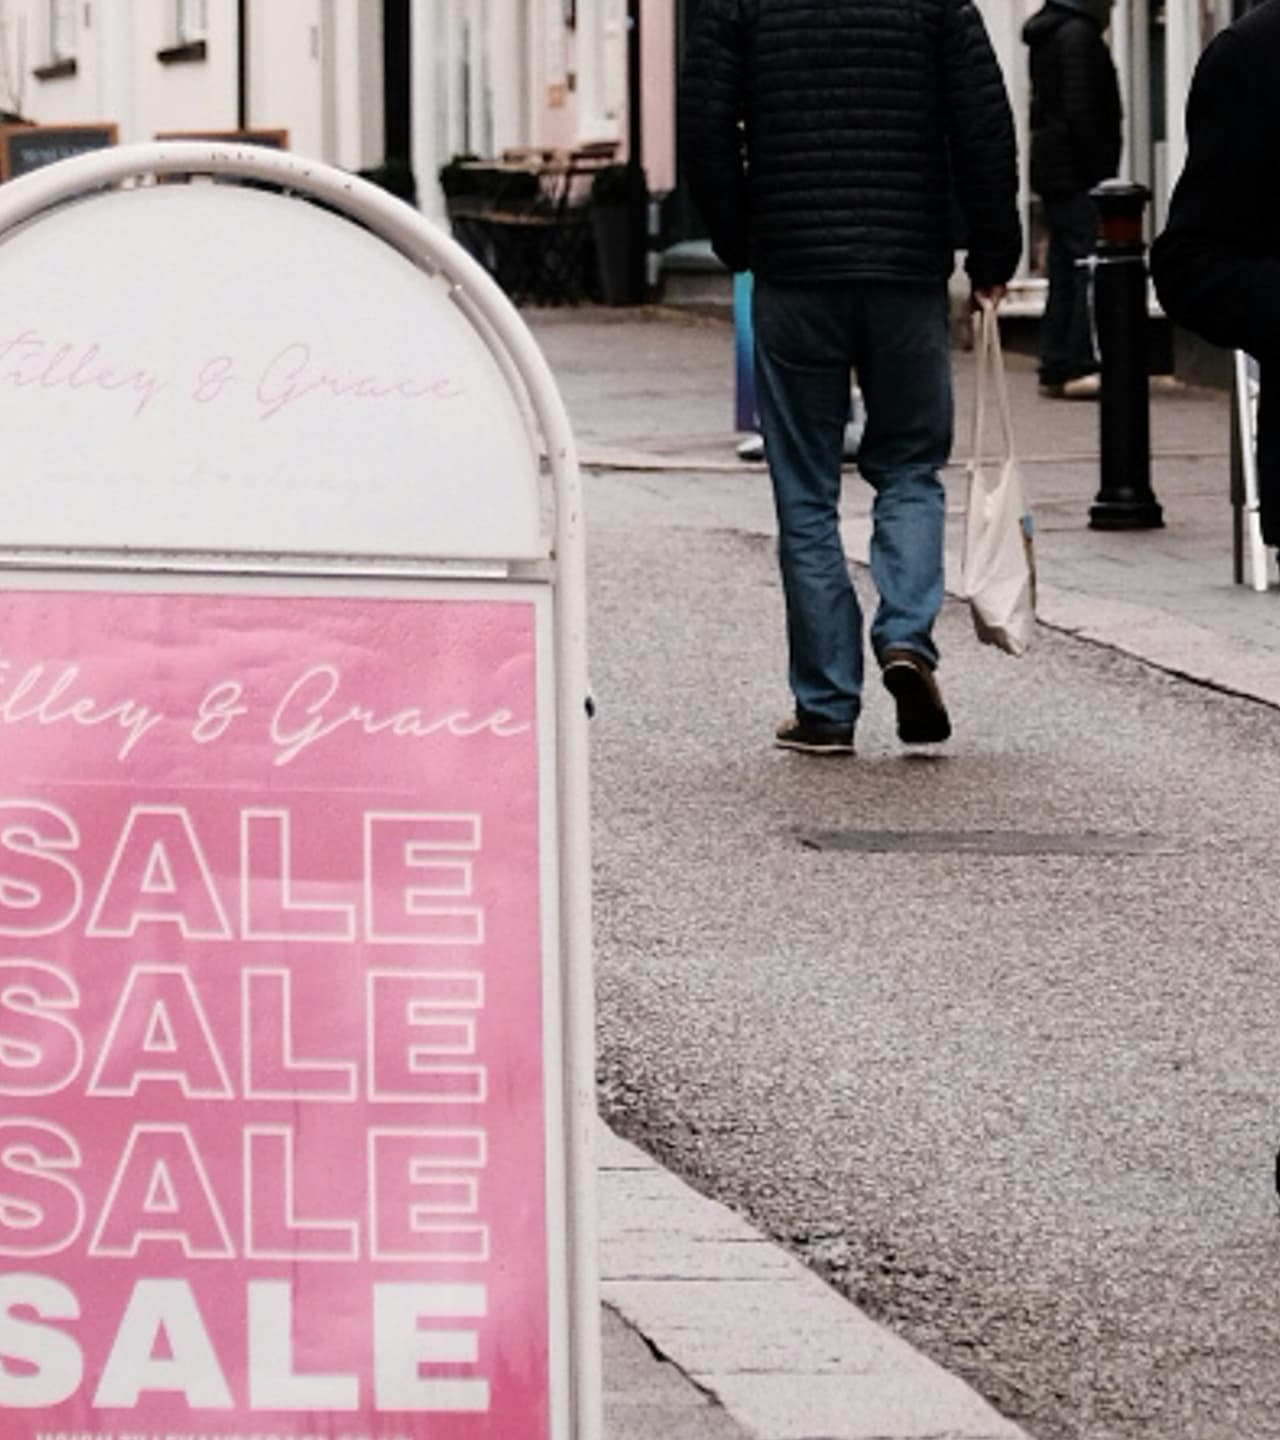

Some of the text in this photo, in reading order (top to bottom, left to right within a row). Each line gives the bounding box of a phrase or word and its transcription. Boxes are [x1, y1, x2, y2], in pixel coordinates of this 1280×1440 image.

[192, 355, 241, 403] &
[257, 342, 466, 421] Grace
[192, 679, 248, 744] &
[269, 666, 532, 765] Grace
